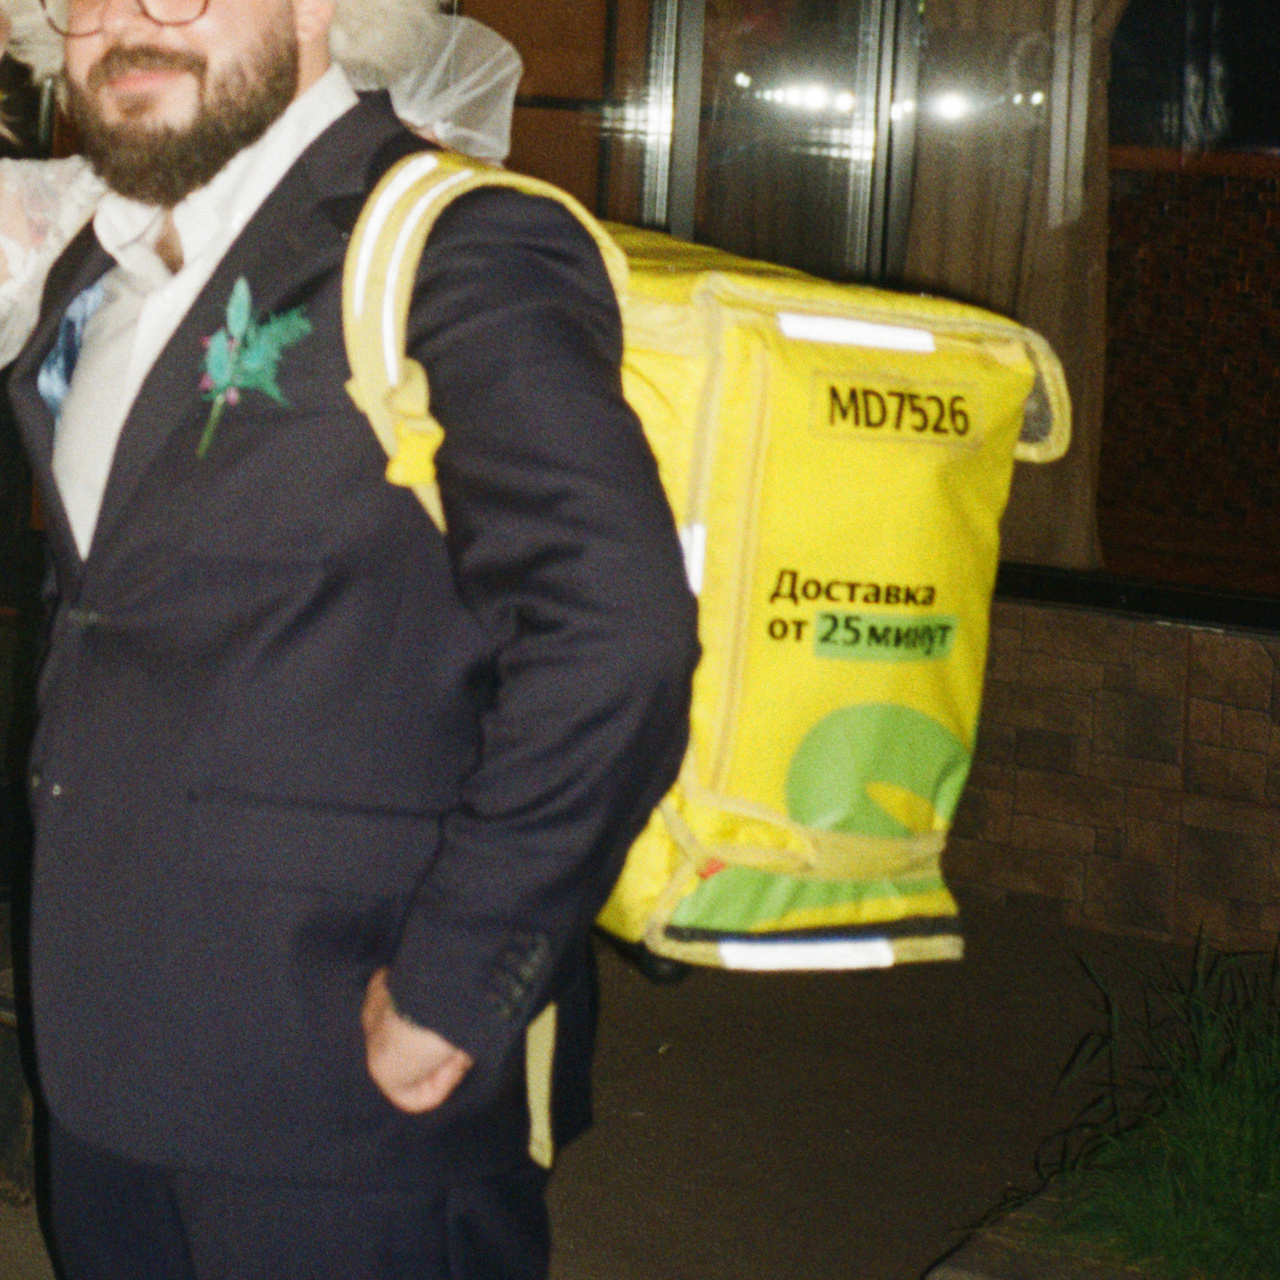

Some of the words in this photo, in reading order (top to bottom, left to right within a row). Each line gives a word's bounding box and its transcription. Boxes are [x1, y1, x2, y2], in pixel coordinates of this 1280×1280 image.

[829, 385, 970, 436] MD7526
[769, 569, 936, 606] Доставка
[768, 618, 809, 643] от
[819, 613, 862, 646] 25
[867, 623, 953, 655] минут
